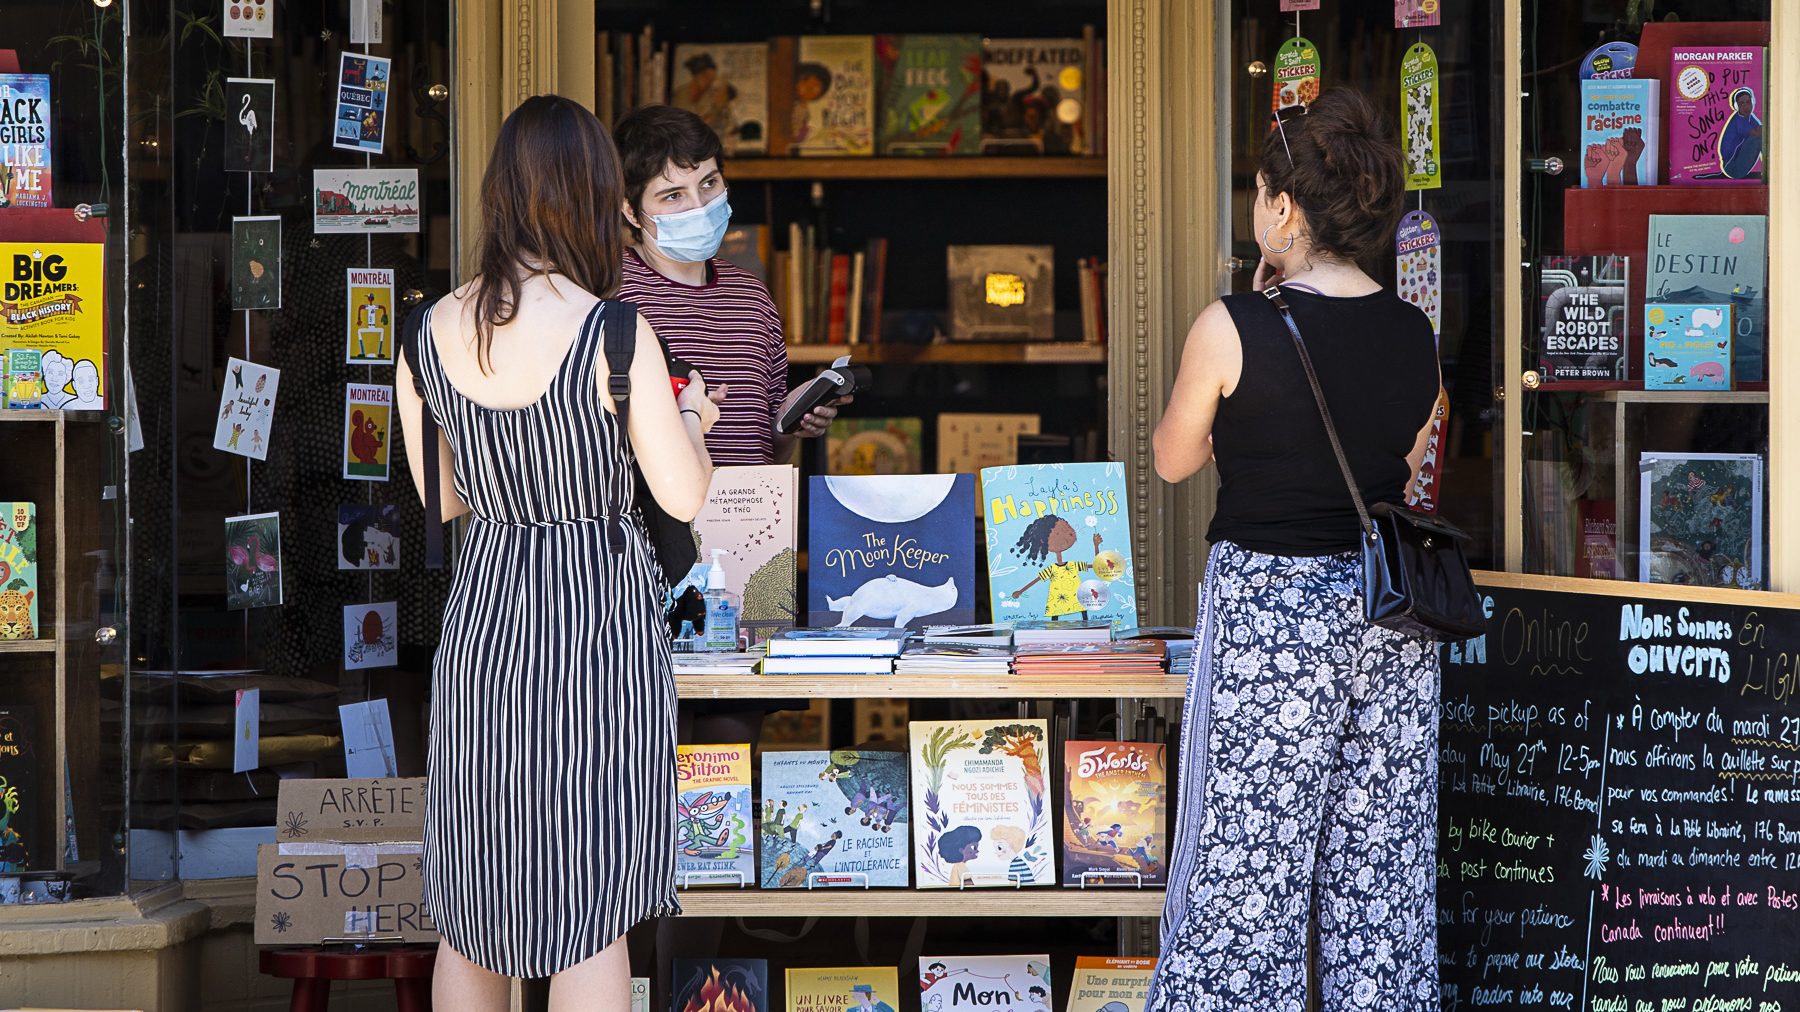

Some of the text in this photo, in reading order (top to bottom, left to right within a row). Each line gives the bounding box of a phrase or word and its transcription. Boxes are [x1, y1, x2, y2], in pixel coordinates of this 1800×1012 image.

[1717, 52, 1753, 60] PARKER
[1722, 68, 1750, 86] PUT
[341, 91, 371, 103] QUÉBEC
[1587, 101, 1641, 111] combattre
[1587, 112, 1642, 132] racisme
[1688, 107, 1725, 139] SONG
[1, 126, 45, 144] GIRLS
[4, 144, 45, 167] LIKE
[1692, 132, 1718, 162] ON?
[15, 169, 42, 191] ME
[343, 180, 416, 201] montréal
[1657, 233, 1672, 248] LE
[1655, 254, 1737, 276] DESTIN
[351, 272, 391, 285] MONTRÉAL
[5, 283, 80, 301] DREAMERS:
[1569, 294, 1598, 306] THE
[1656, 279, 1672, 300] de
[10, 302, 72, 322] BLACK HISTORY
[1564, 306, 1605, 320] WILD
[1555, 321, 1610, 335] ROBOT
[1547, 336, 1618, 350] ESCAPES
[1555, 369, 1610, 377] PETER BROWN
[350, 388, 390, 402] MONTRÉAL
[729, 488, 756, 496] GRANDE
[1025, 476, 1078, 499] Layla's
[710, 496, 763, 505] MÉTAMORPHOSE
[991, 489, 1119, 525] Happiness
[862, 532, 886, 548] The
[826, 534, 949, 577] Moon Keeper
[1501, 608, 1593, 665] Online
[1619, 604, 1765, 649] Nous Sommes En
[1487, 699, 1592, 739] pickup as of
[1632, 694, 1643, 731] À
[1706, 706, 1724, 734] du
[1733, 714, 1770, 738] mardi
[964, 759, 1004, 767] CHIMAMANDA
[1077, 746, 1150, 778] 5 Worlds
[1480, 743, 1510, 785] May
[1609, 747, 1638, 767] nous
[1645, 744, 1696, 770] offrirons
[1702, 743, 1714, 770] la
[1771, 755, 1791, 771] sur
[677, 762, 730, 781] Stilton
[319, 780, 414, 814] ARRÊTE
[952, 782, 1018, 792] NOUS SOMMES
[966, 792, 1006, 801] TOUS DES
[1555, 784, 1573, 807] 176
[1607, 786, 1634, 806] pour
[1640, 787, 1658, 803] vos
[1746, 784, 1759, 805] Le
[1449, 816, 1463, 851] by
[1469, 818, 1497, 844] bike
[1611, 819, 1624, 835] se
[1630, 817, 1648, 836] fera
[1655, 813, 1663, 837] à
[1670, 818, 1681, 837] La
[1754, 819, 1773, 842] 176
[842, 837, 893, 852] LE RACISME
[698, 861, 736, 870] RAT STINK
[834, 857, 900, 873] L'INTOLÉRANCE
[1617, 846, 1778, 869] du mardi au dimanche entre
[1461, 858, 1487, 882] post
[271, 863, 406, 900] STOP
[1616, 886, 1633, 910] Les
[1639, 887, 1682, 909] livraisons
[1686, 885, 1694, 906] à
[1721, 884, 1731, 907] et
[1736, 891, 1759, 907] avec
[1767, 885, 1799, 911] Postes
[351, 902, 438, 933] HERE
[1462, 891, 1480, 923] for
[1481, 909, 1516, 947] your
[1601, 918, 1643, 944] Canada
[1466, 945, 1477, 968] to
[1525, 952, 1545, 970] our
[1086, 975, 1109, 986] Une
[1592, 956, 1619, 984] Nous
[1625, 963, 1646, 982] vous
[1703, 961, 1730, 988] pour
[1735, 954, 1759, 979] votre
[796, 994, 848, 1005] UN LIVRE
[953, 982, 1010, 1006] Mon
[1078, 989, 1133, 1000] pour mon
[1470, 984, 1514, 1006] readers
